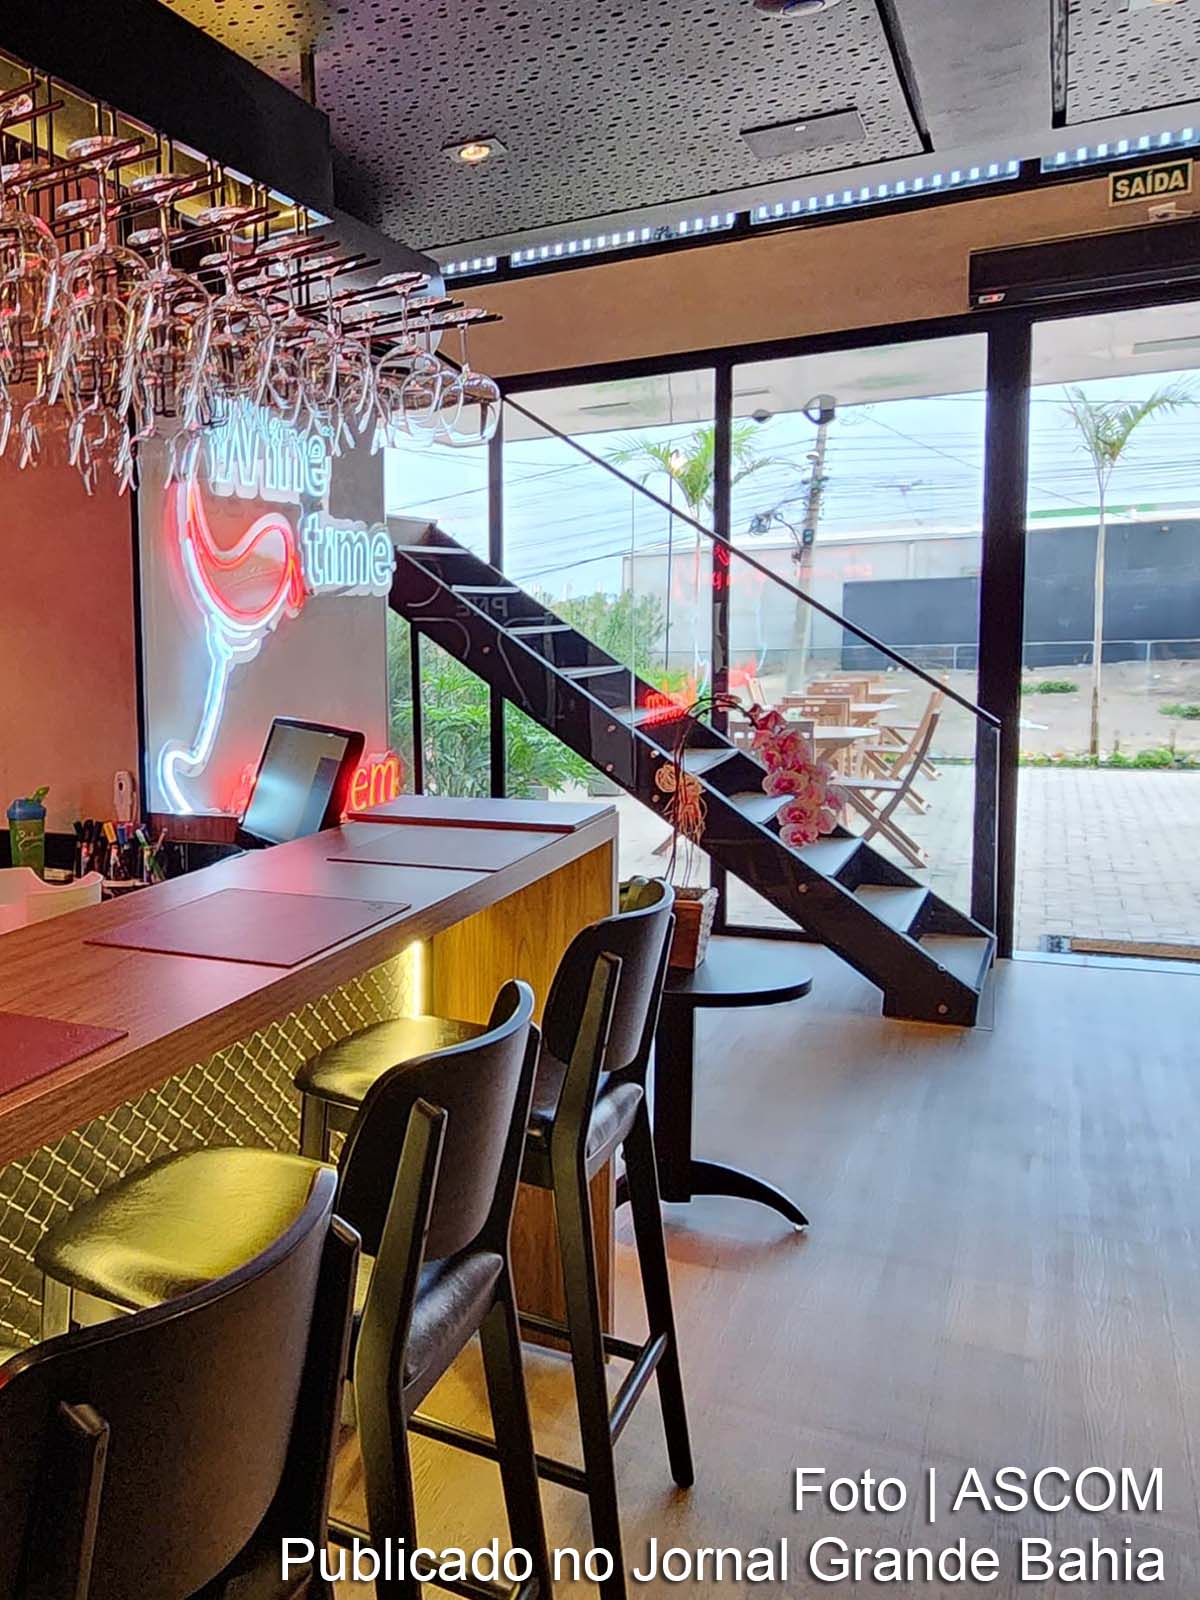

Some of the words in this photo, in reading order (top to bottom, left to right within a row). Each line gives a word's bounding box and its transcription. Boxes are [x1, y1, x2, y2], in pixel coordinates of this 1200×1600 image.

[1115, 170, 1185, 198] SAÍDA
[209, 403, 331, 497] Wine
[304, 513, 392, 586] time
